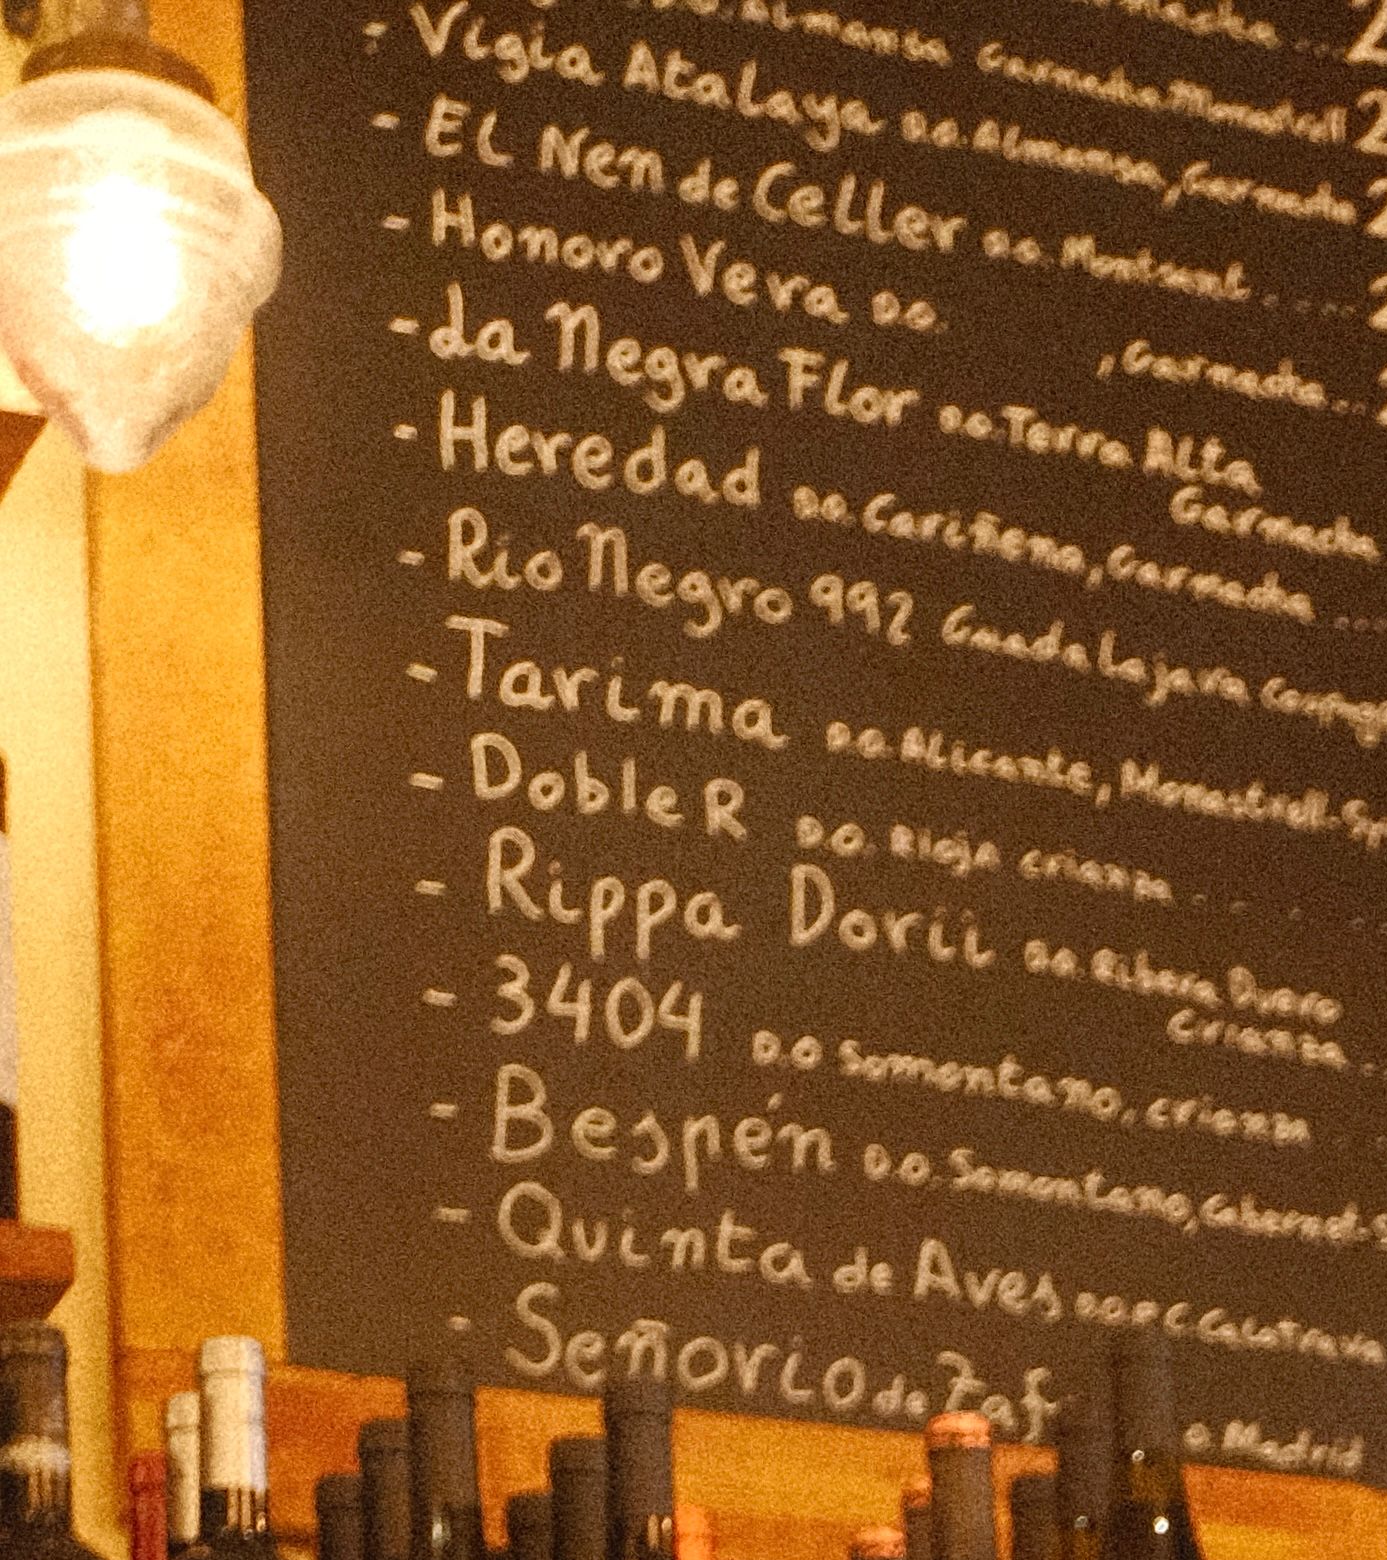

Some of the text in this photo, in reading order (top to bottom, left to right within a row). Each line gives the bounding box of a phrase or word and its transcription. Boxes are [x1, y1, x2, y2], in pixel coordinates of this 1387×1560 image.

[623, 41, 886, 153] Atalaya
[540, 121, 665, 194] Nen
[678, 158, 741, 212] de
[752, 161, 969, 252] Celler
[431, 187, 664, 284] Honoro
[681, 233, 851, 326] Vera
[545, 300, 770, 415] Negra
[780, 346, 920, 427] Flor
[437, 387, 763, 508] Heredad
[576, 520, 794, 638] Negro
[445, 613, 790, 750] Tarima
[470, 731, 684, 828] Doble
[704, 776, 750, 840] R
[485, 826, 743, 961] Rippa
[790, 863, 997, 969] Dorii
[490, 953, 702, 1063] 3404
[490, 1063, 838, 1194] Bespén
[499, 1180, 813, 1292] Quinta
[832, 1246, 894, 1297] de
[912, 1238, 1063, 1324] Aves
